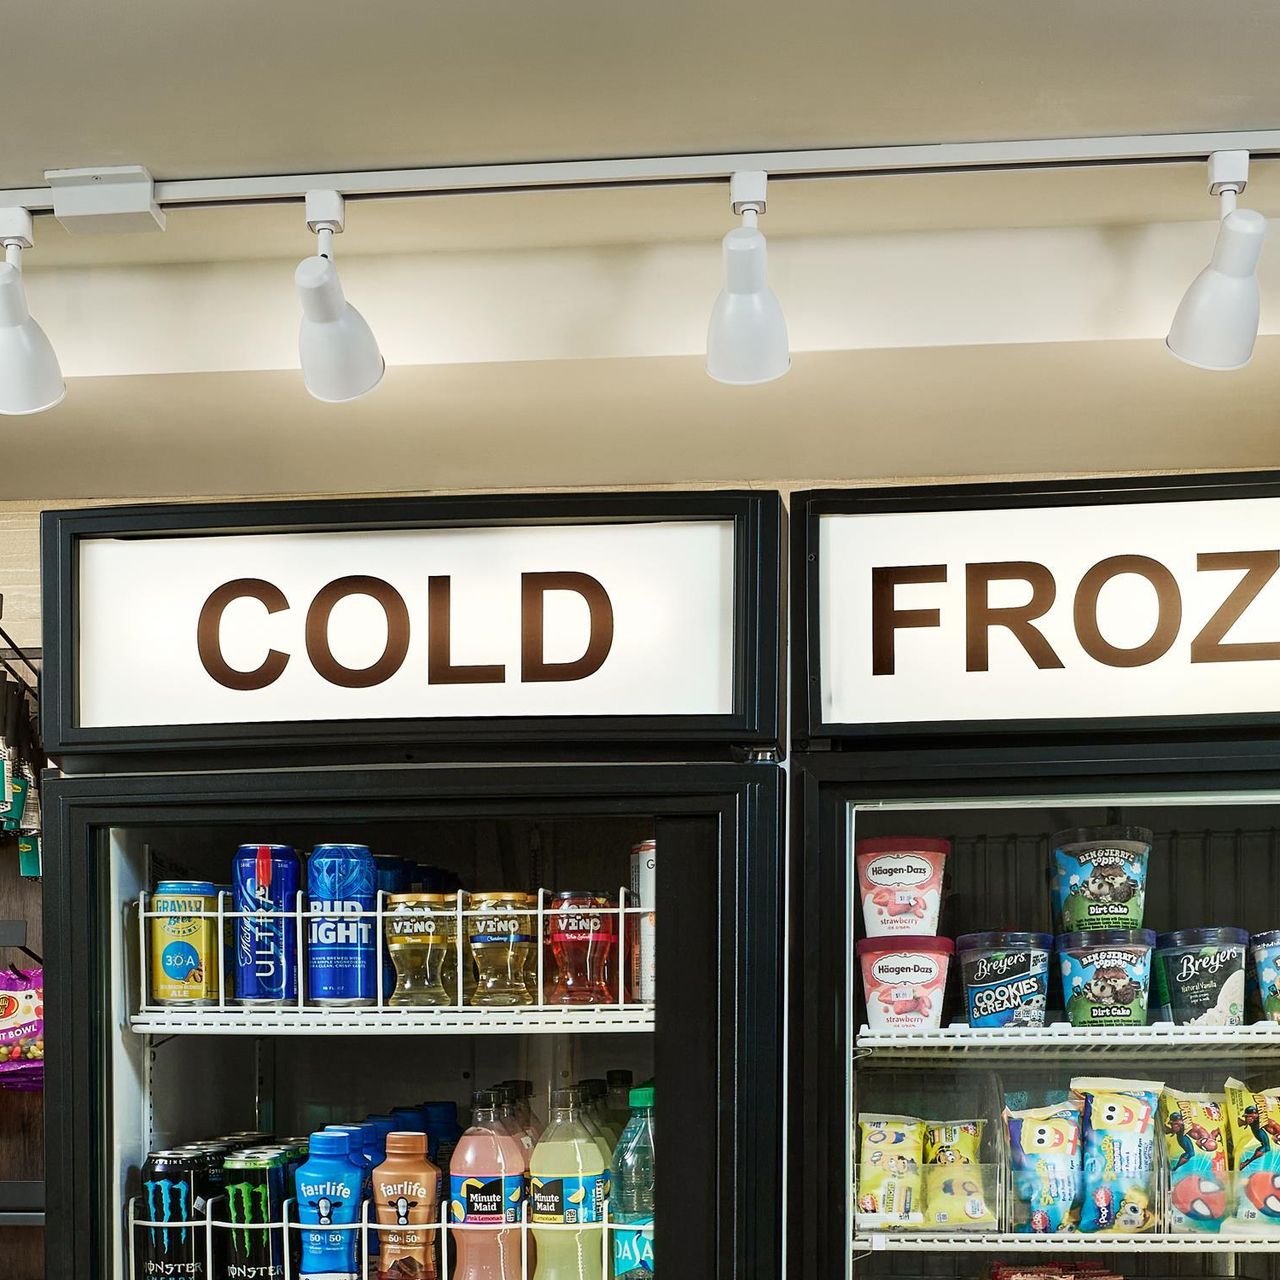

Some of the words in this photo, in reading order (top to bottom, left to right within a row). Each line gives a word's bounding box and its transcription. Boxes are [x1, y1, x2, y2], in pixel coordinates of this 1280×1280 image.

[197, 571, 614, 691] COLD
[872, 866, 927, 877] Häagen-Dazs
[311, 901, 363, 921] BUD
[1089, 906, 1106, 915] Dirt
[1108, 905, 1128, 915] Cake
[880, 917, 918, 926] strawberry
[878, 964, 933, 974] Häagen-Dazs
[974, 978, 1038, 1006] COOKIES
[8, 1026, 36, 1038] BOWL
[301, 1182, 351, 1199] fairlife
[381, 1181, 427, 1198] fairlife
[470, 1193, 501, 1202] Minute
[534, 1193, 559, 1202] Minute
[474, 1202, 497, 1211] Maid
[536, 1202, 555, 1212] Maid
